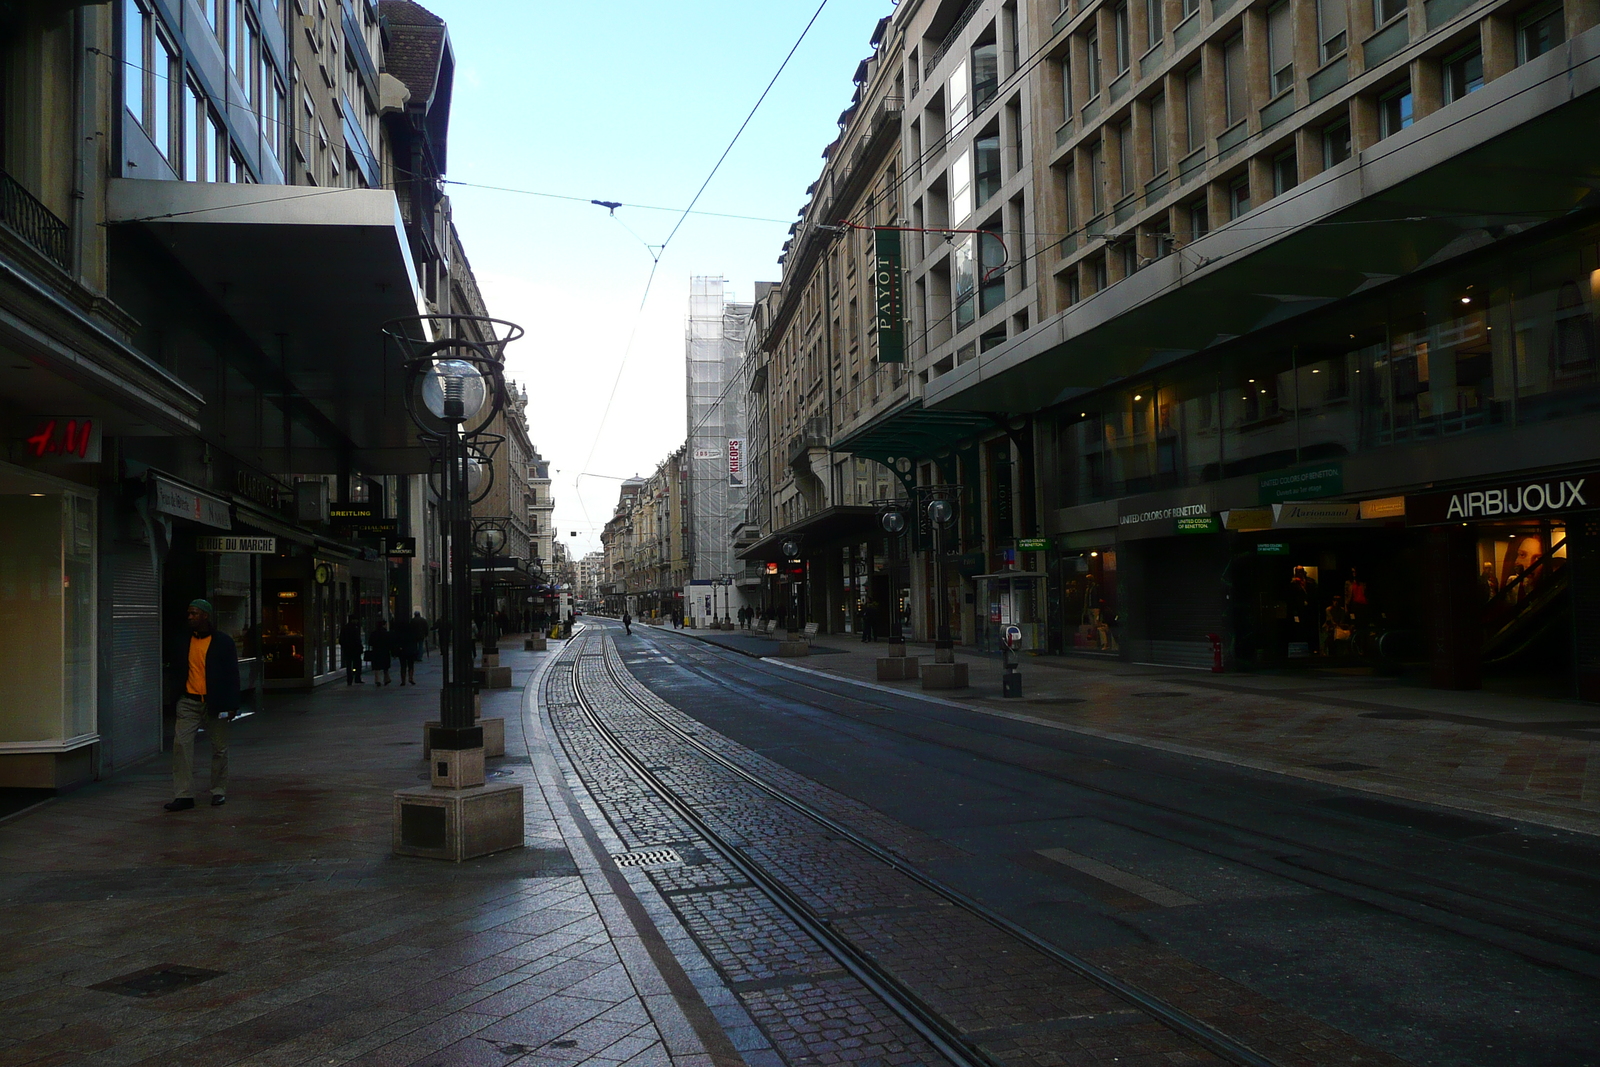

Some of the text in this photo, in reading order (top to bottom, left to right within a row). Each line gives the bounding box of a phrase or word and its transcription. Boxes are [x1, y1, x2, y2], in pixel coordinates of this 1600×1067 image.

[878, 257, 892, 330] PAYOT
[26, 419, 92, 458] H&M
[729, 440, 739, 473] KHEOPS
[1261, 478, 1279, 488] UNITED
[1280, 475, 1301, 485] COLORS
[1301, 473, 1309, 481] OF
[998, 482, 1007, 520] PAYOT
[1284, 507, 1349, 519] Marionnaud
[1446, 478, 1587, 519] AIRBIJOUX
[1119, 514, 1139, 525] UNITED
[1140, 511, 1163, 523] COLORS
[1163, 509, 1173, 520] OF
[207, 538, 223, 550] RUE
[225, 538, 237, 550] DU
[239, 537, 273, 551] MARCHÉ
